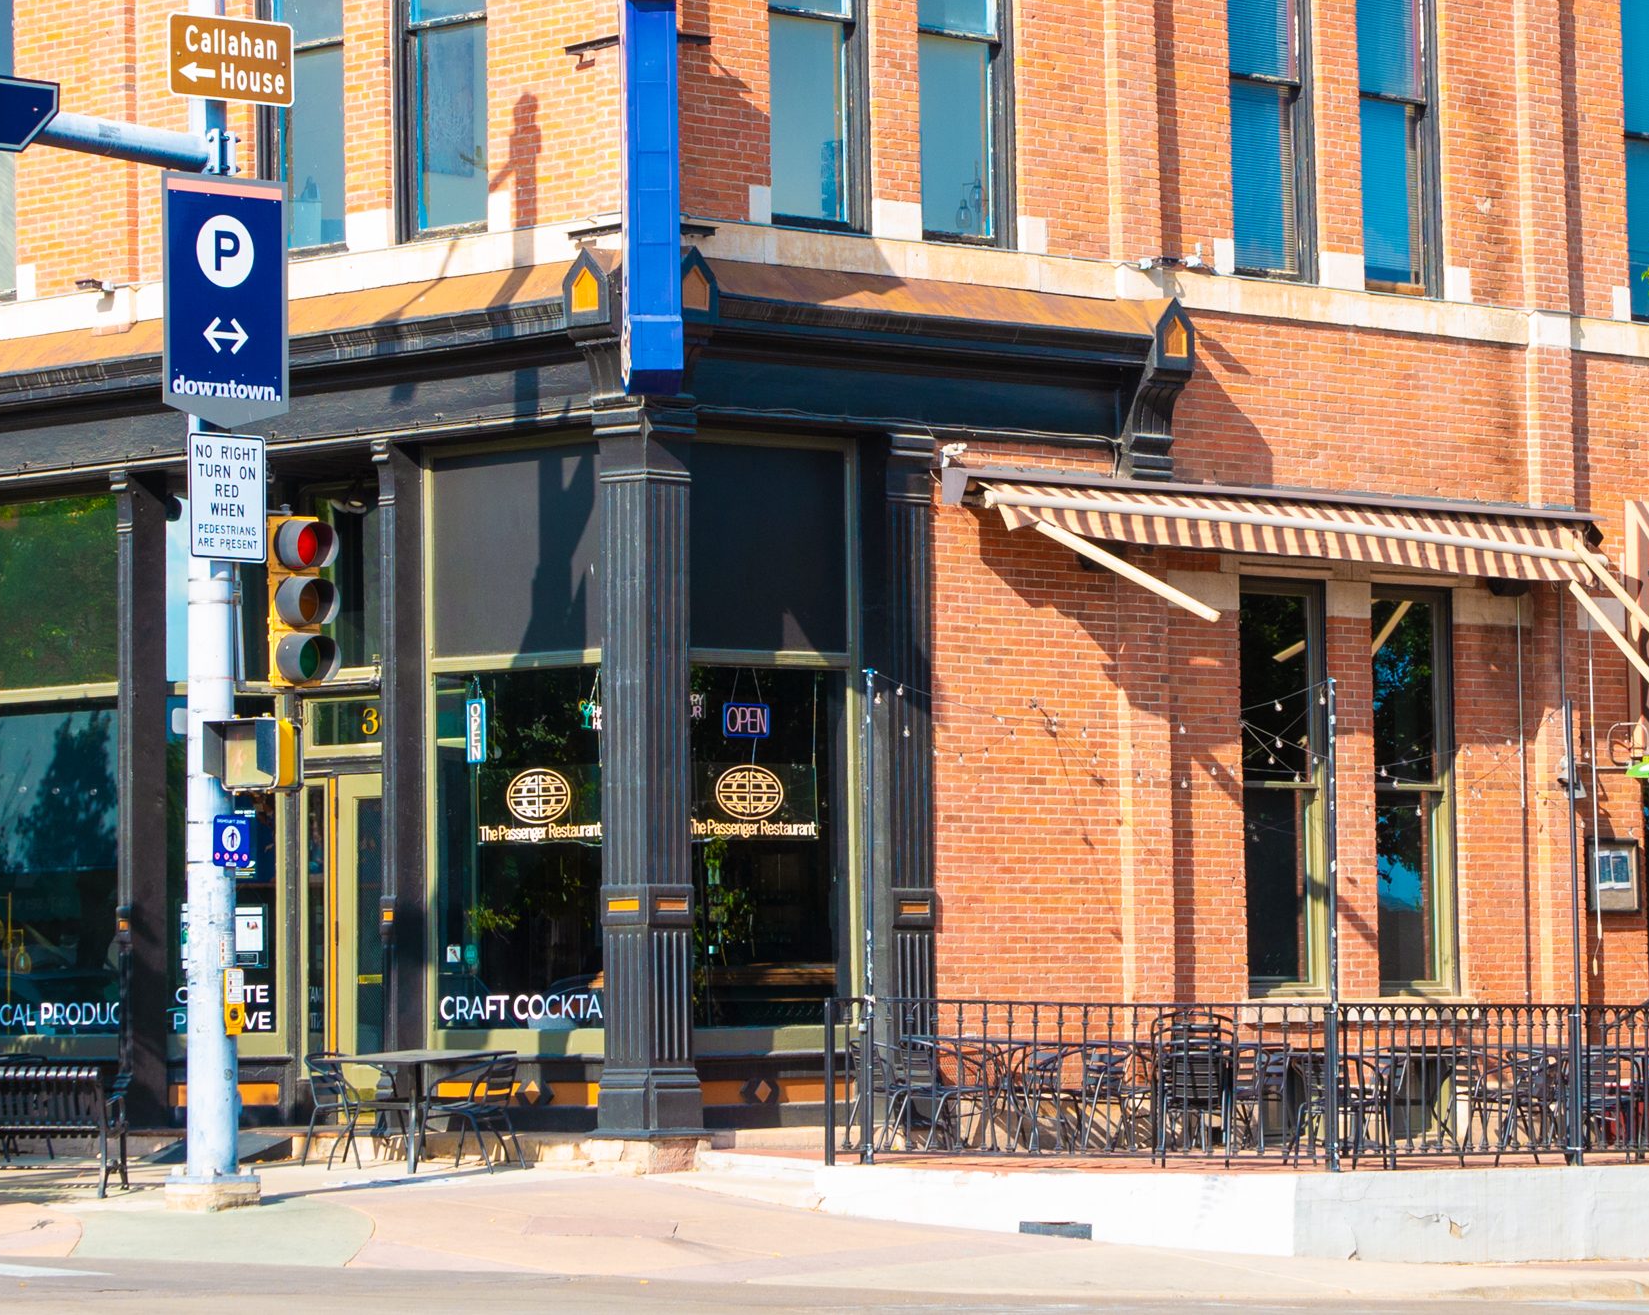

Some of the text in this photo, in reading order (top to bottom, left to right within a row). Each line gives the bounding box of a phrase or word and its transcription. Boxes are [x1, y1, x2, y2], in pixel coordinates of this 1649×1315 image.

[185, 25, 278, 62] Callahan
[221, 64, 285, 95] House
[214, 230, 240, 272] P
[172, 374, 281, 402] downtown.
[196, 444, 258, 462] NO RIGHT
[198, 463, 256, 480] TURN ON
[215, 483, 239, 498] RED
[210, 502, 245, 518] WHEN
[198, 523, 257, 536] PEDESTRIANS
[198, 537, 258, 550] ARE PRESENT
[726, 707, 767, 734] OPEN
[470, 703, 481, 761] OPEN
[479, 822, 602, 842] The Passenger Restaurant
[707, 819, 759, 838] Passenger
[761, 820, 816, 836] Restaurant
[40, 1001, 120, 1026] PRODUC
[440, 993, 603, 1021] CRAFT COCKTA
